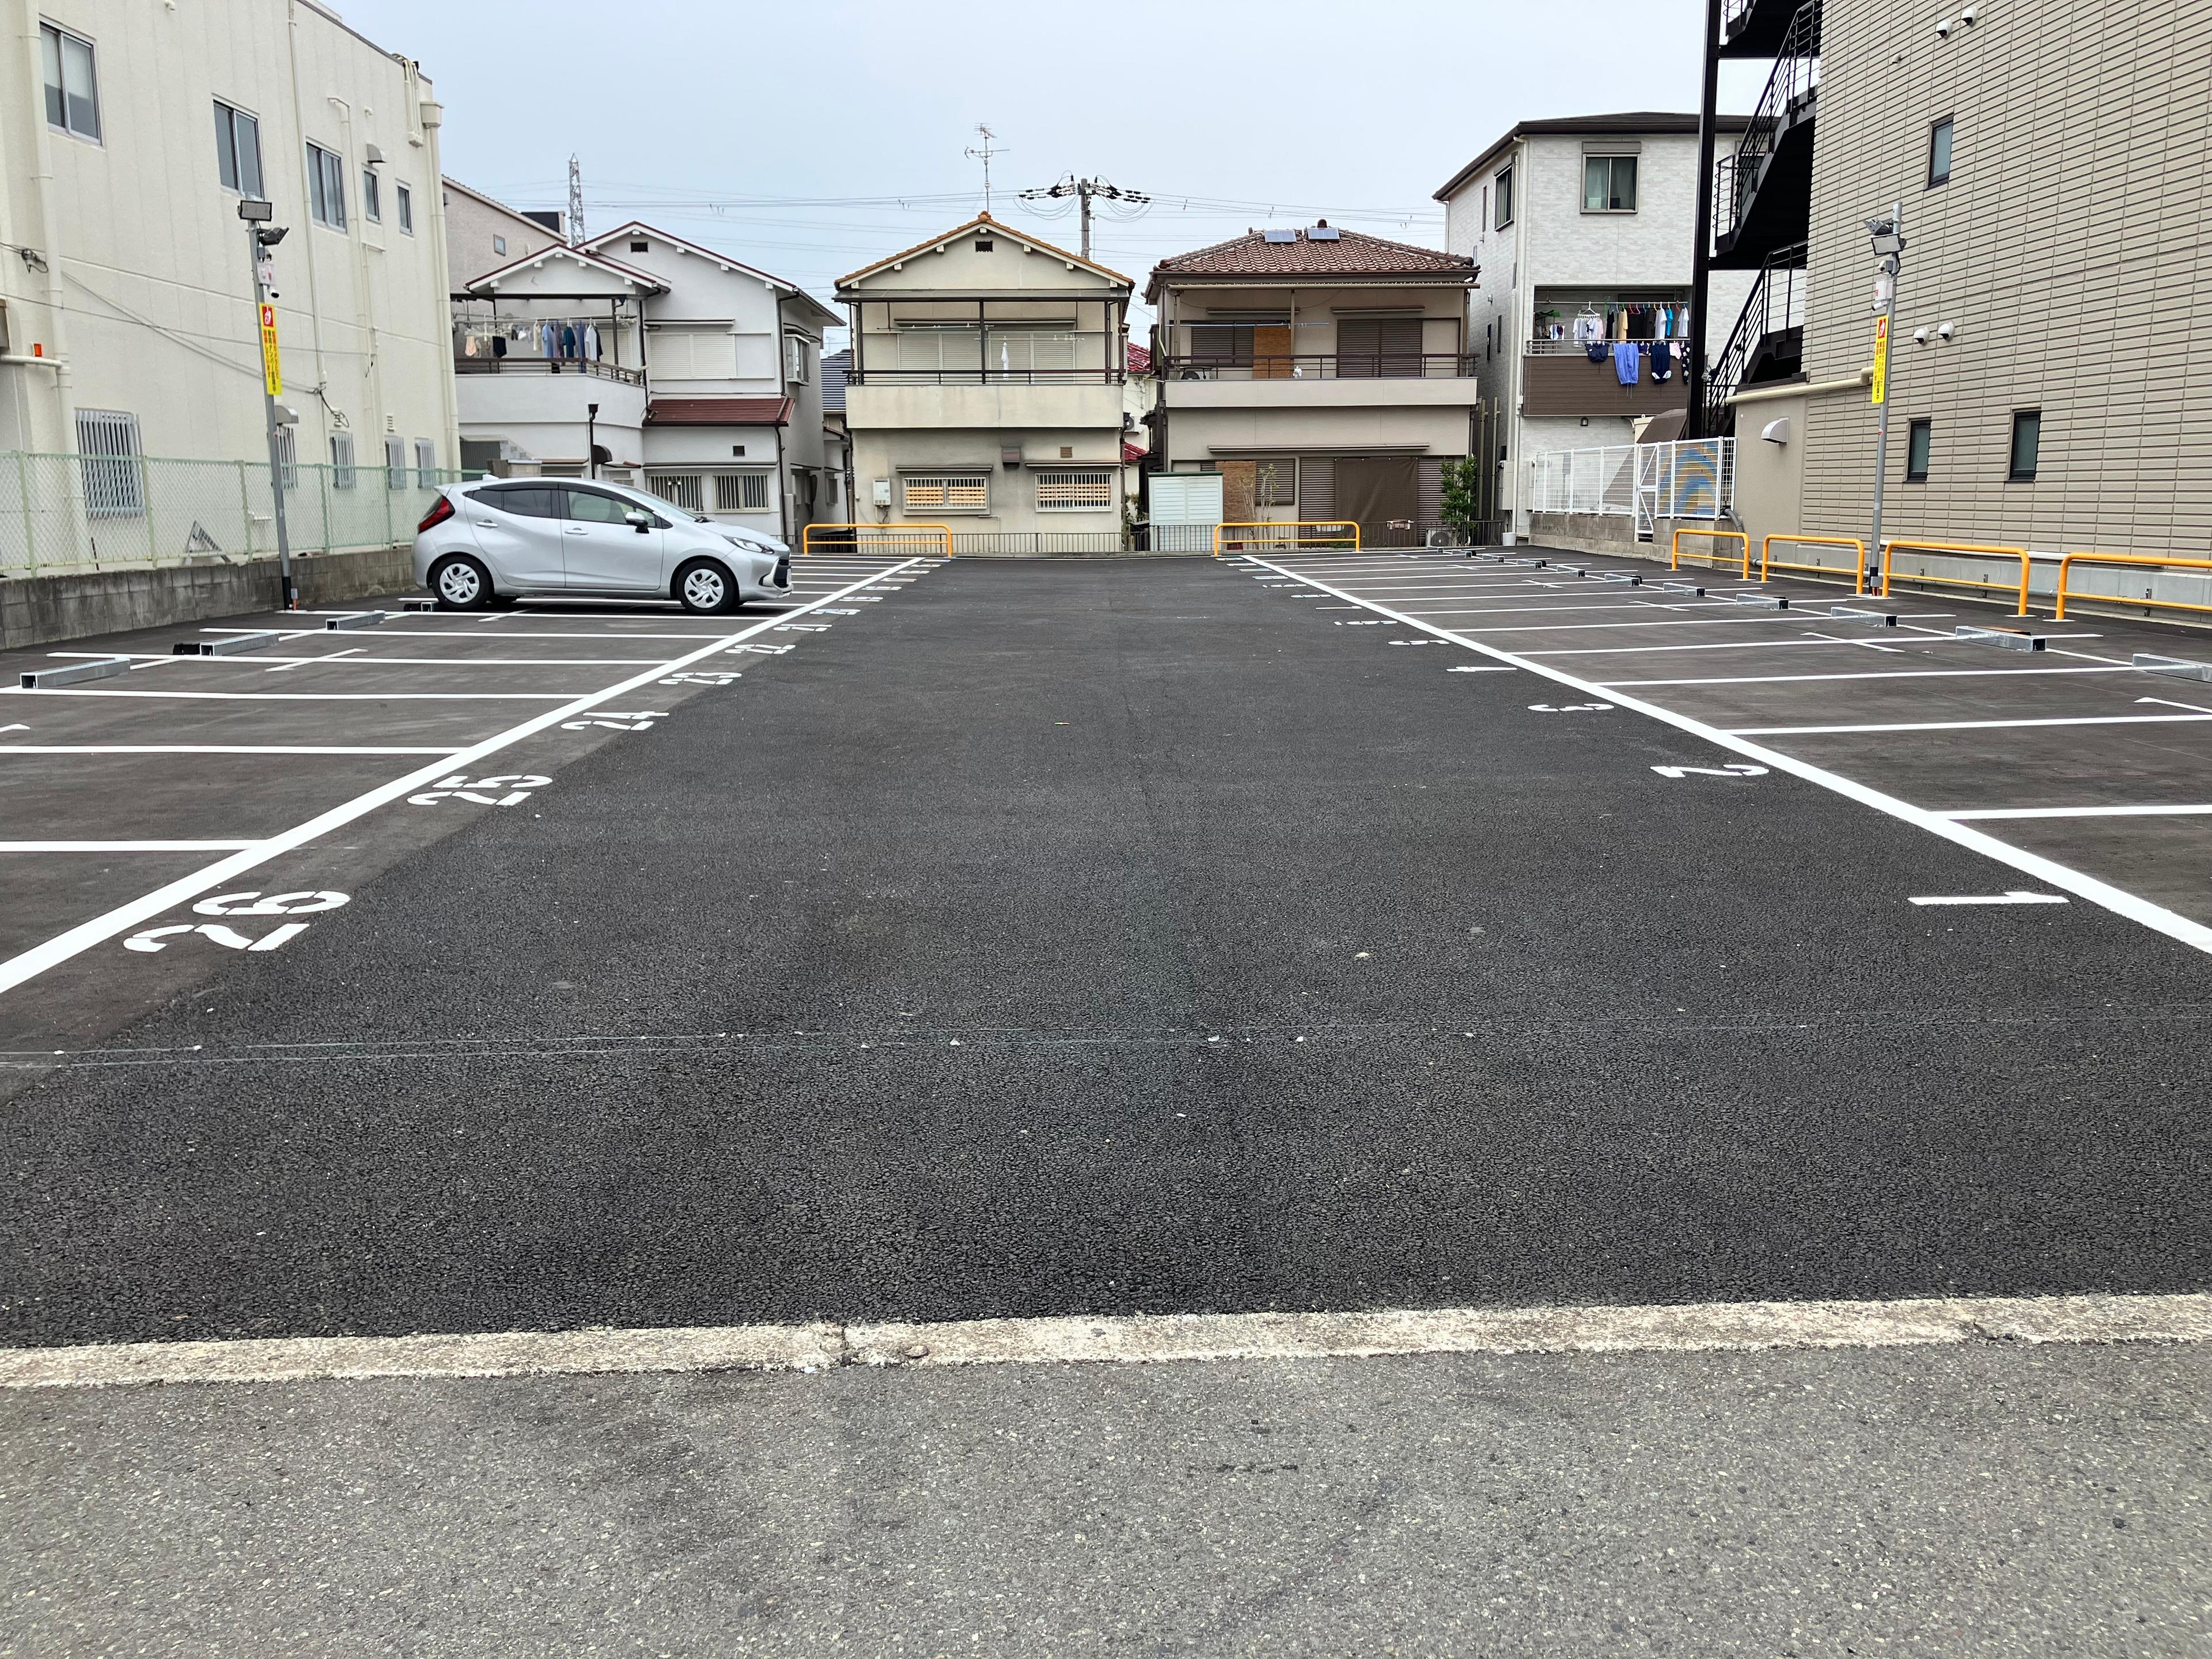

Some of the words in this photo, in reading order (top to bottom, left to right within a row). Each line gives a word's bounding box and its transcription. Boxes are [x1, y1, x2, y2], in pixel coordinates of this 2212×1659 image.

[772, 624, 833, 632] 21
[724, 643, 796, 654] 22
[658, 672, 742, 685] 23
[1527, 703, 1615, 712] 3
[560, 711, 669, 730] 24
[1650, 764, 1770, 778] 2
[407, 775, 553, 806] 25
[1907, 891, 2070, 906] 1
[123, 891, 352, 952] 26
